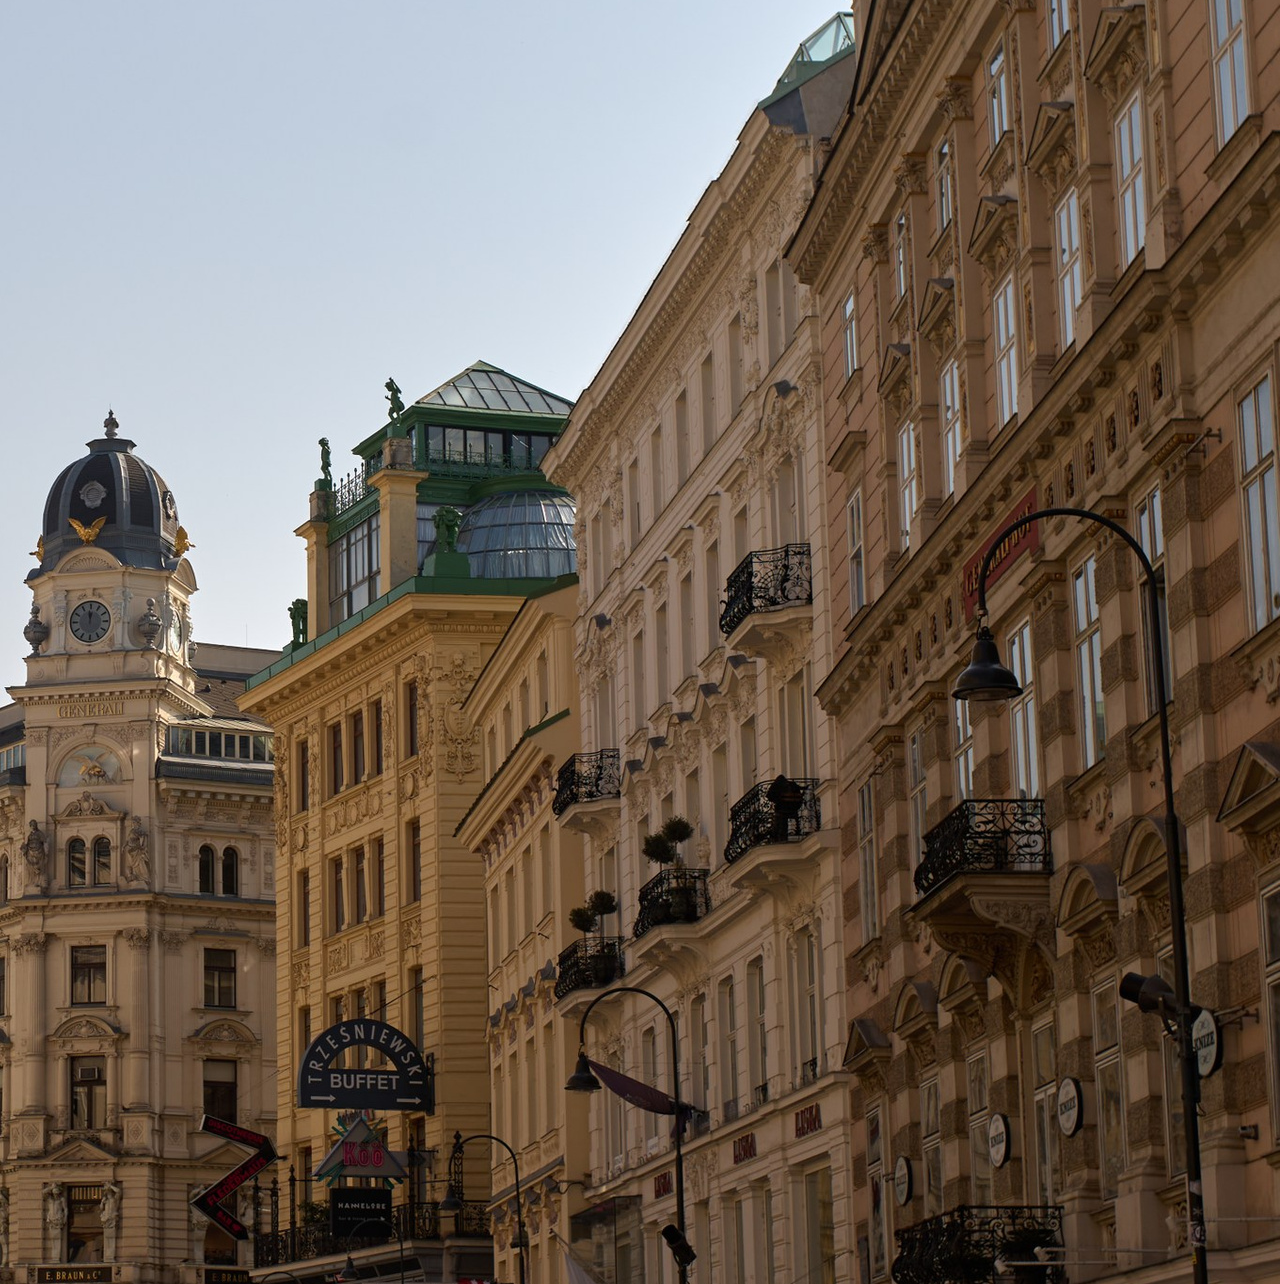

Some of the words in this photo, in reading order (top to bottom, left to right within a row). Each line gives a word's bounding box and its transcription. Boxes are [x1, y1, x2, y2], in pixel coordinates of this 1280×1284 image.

[330, 1073, 400, 1090] BUFFET
[56, 1270, 84, 1281] BRAUN
[221, 1273, 248, 1283] BRAUN
